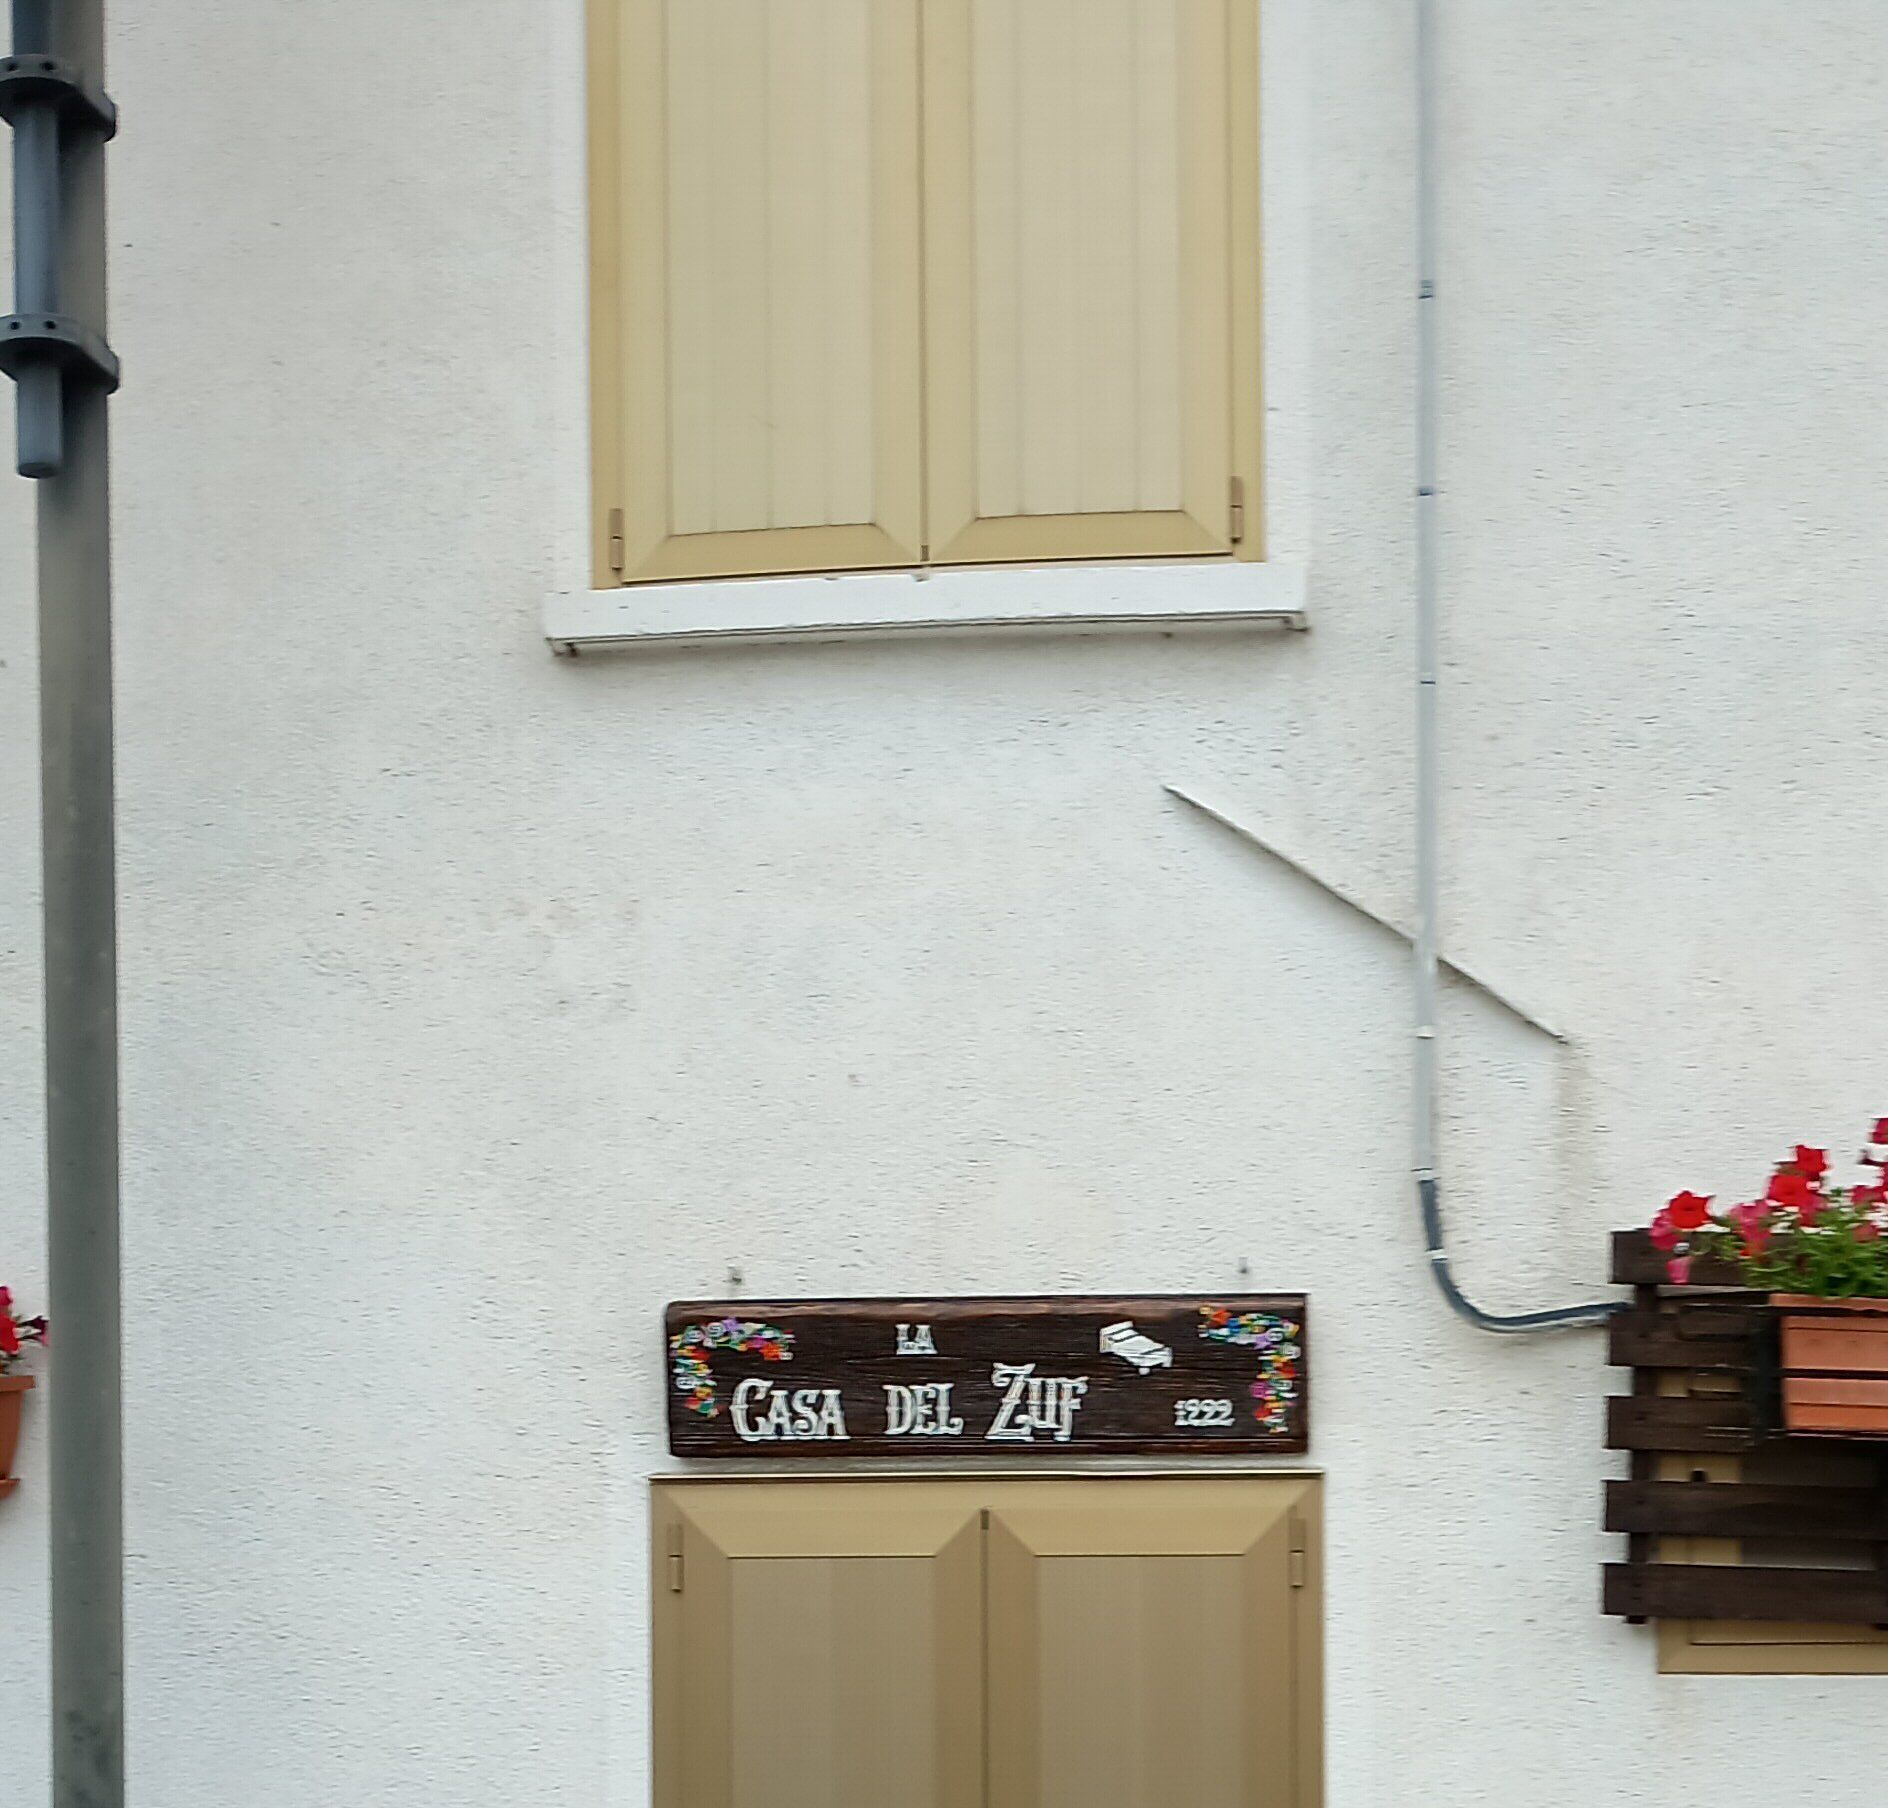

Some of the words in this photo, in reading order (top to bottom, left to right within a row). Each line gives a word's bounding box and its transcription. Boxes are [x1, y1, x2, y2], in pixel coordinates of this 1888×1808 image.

[895, 1323, 938, 1355] LA
[882, 1382, 964, 1435] DEL
[984, 1362, 1090, 1442] ZUF
